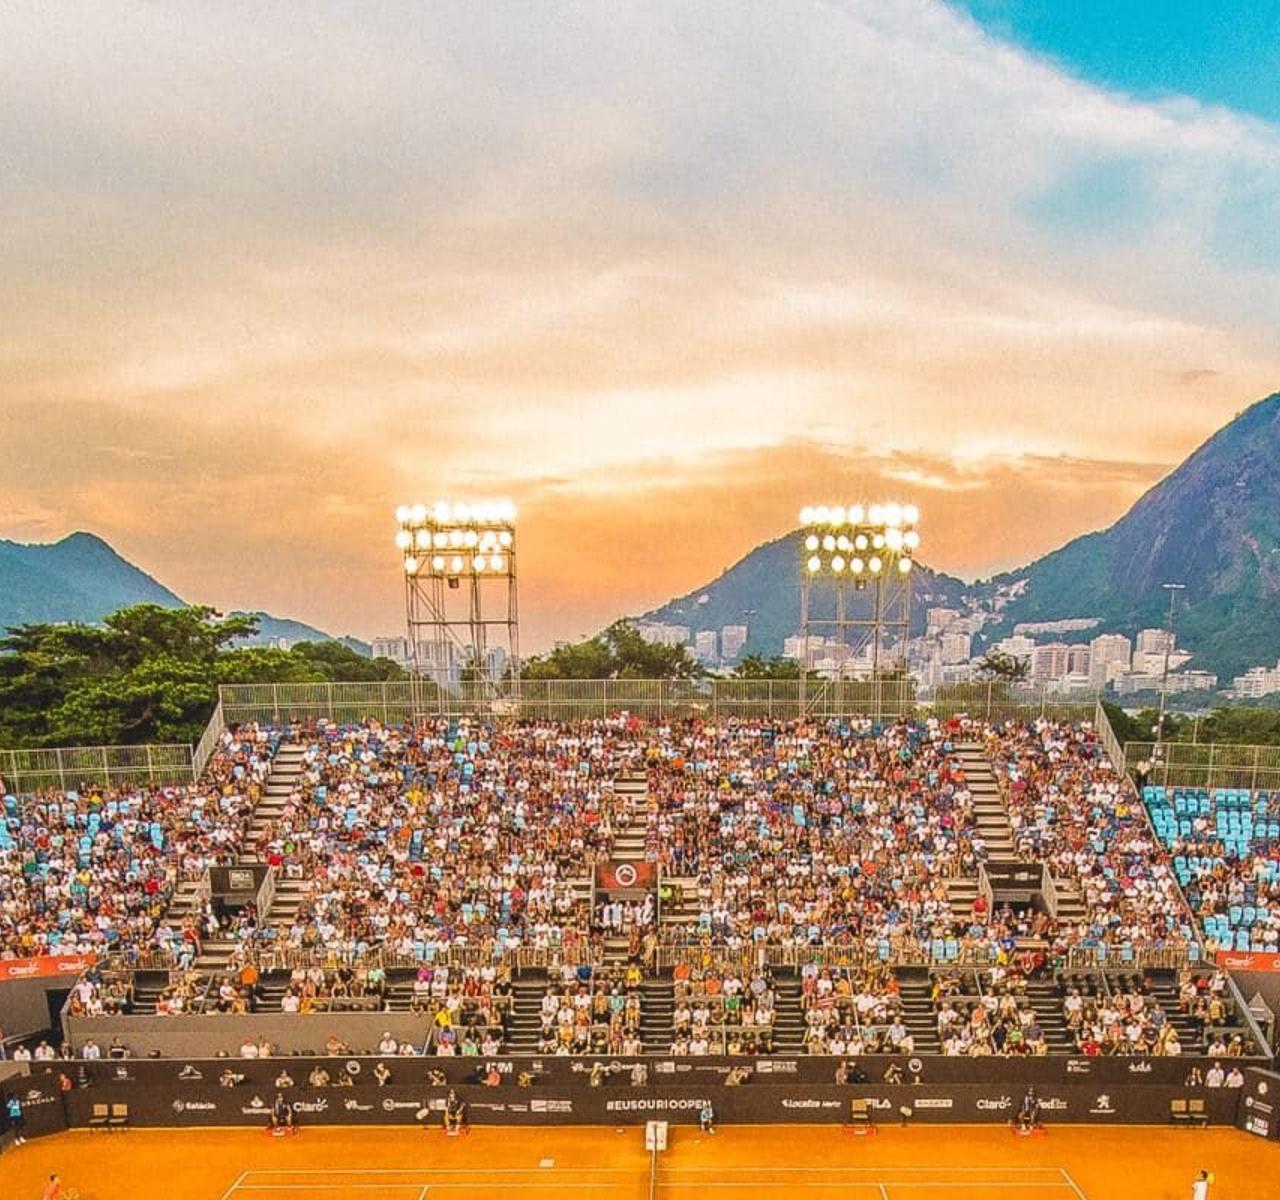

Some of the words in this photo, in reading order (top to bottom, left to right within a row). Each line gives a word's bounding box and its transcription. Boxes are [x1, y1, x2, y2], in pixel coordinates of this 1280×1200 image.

[1224, 955, 1254, 968] Claro
[8, 961, 39, 977] Claro
[293, 1099, 327, 1112] Claro
[606, 1099, 712, 1112] #EUSOURIOOPEN
[976, 1097, 1011, 1109] Claro
